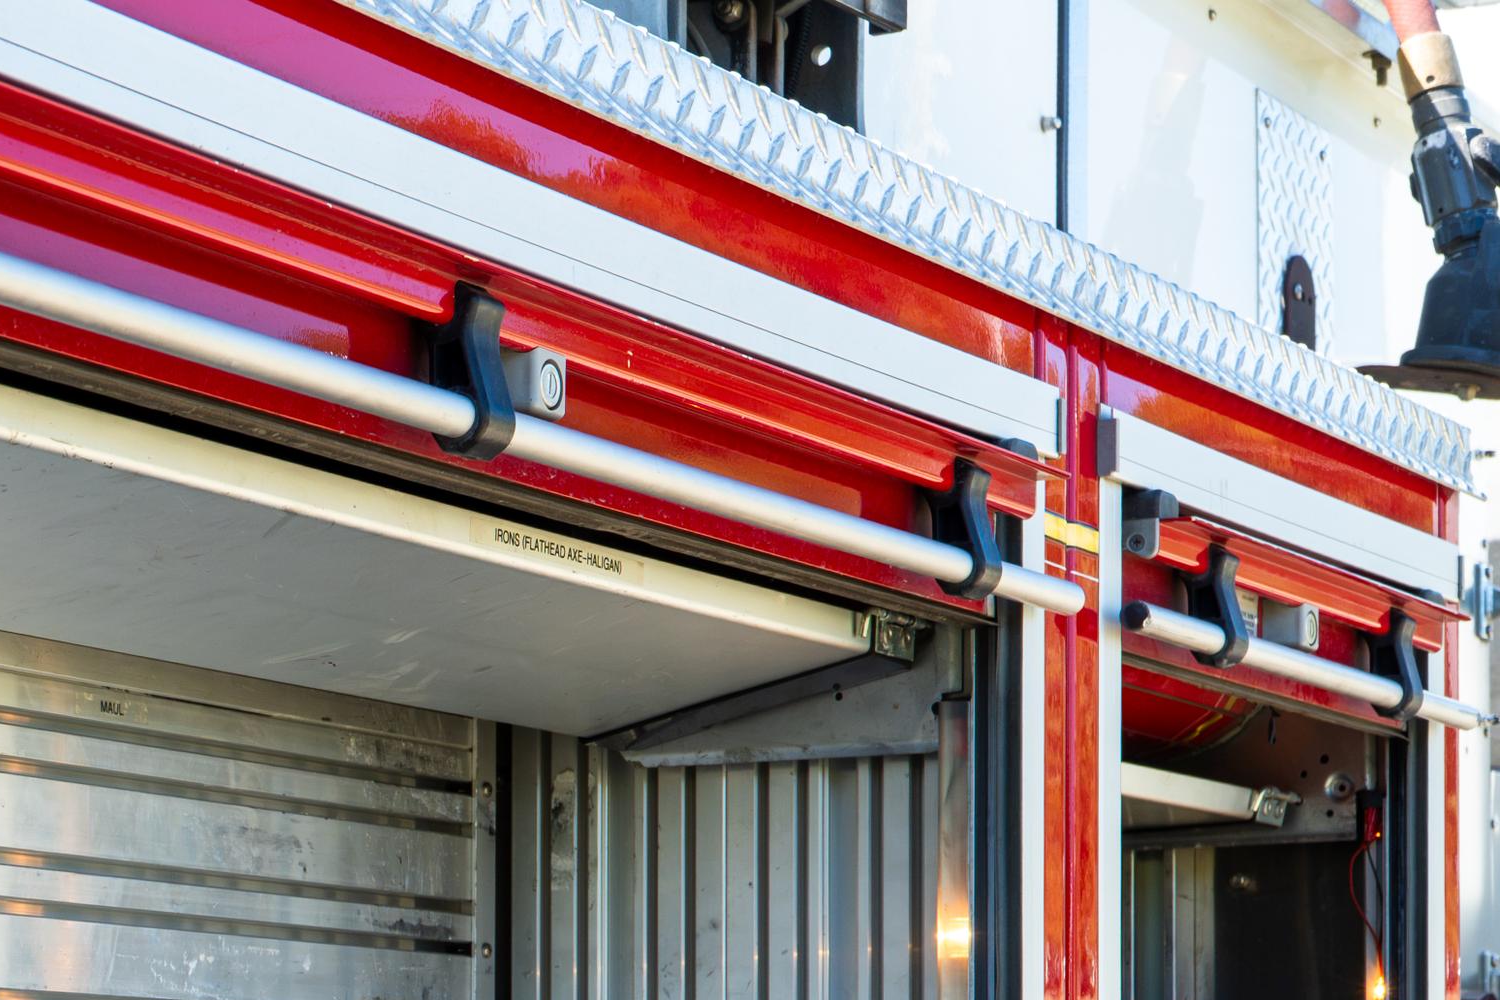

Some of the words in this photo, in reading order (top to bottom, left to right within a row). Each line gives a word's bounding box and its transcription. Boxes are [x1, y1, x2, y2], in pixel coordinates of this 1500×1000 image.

[494, 527, 521, 548] IRONS
[522, 534, 567, 559] (FLATHEAD
[567, 548, 623, 575] AXE-HALIGAN)
[100, 700, 125, 717] MAUL
